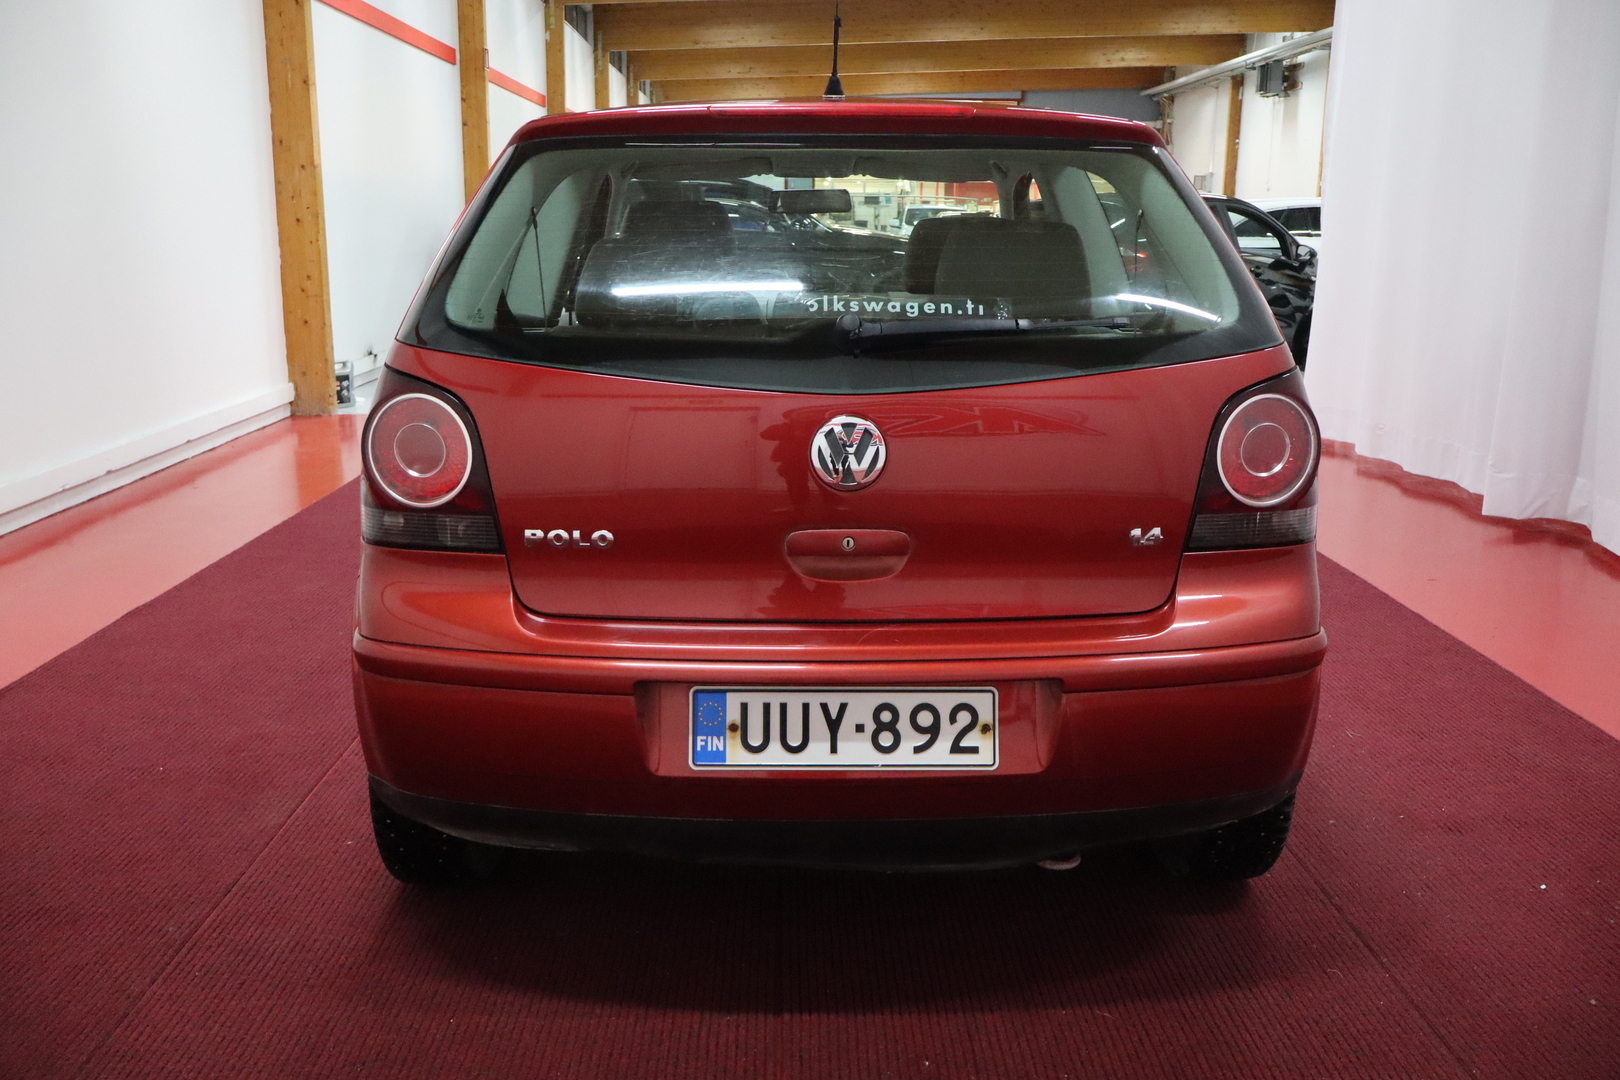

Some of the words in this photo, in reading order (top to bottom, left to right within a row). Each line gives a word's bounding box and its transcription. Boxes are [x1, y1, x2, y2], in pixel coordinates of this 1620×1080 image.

[524, 529, 615, 548] POLO
[740, 702, 980, 754] UUY-892
[696, 735, 724, 751] FIN
